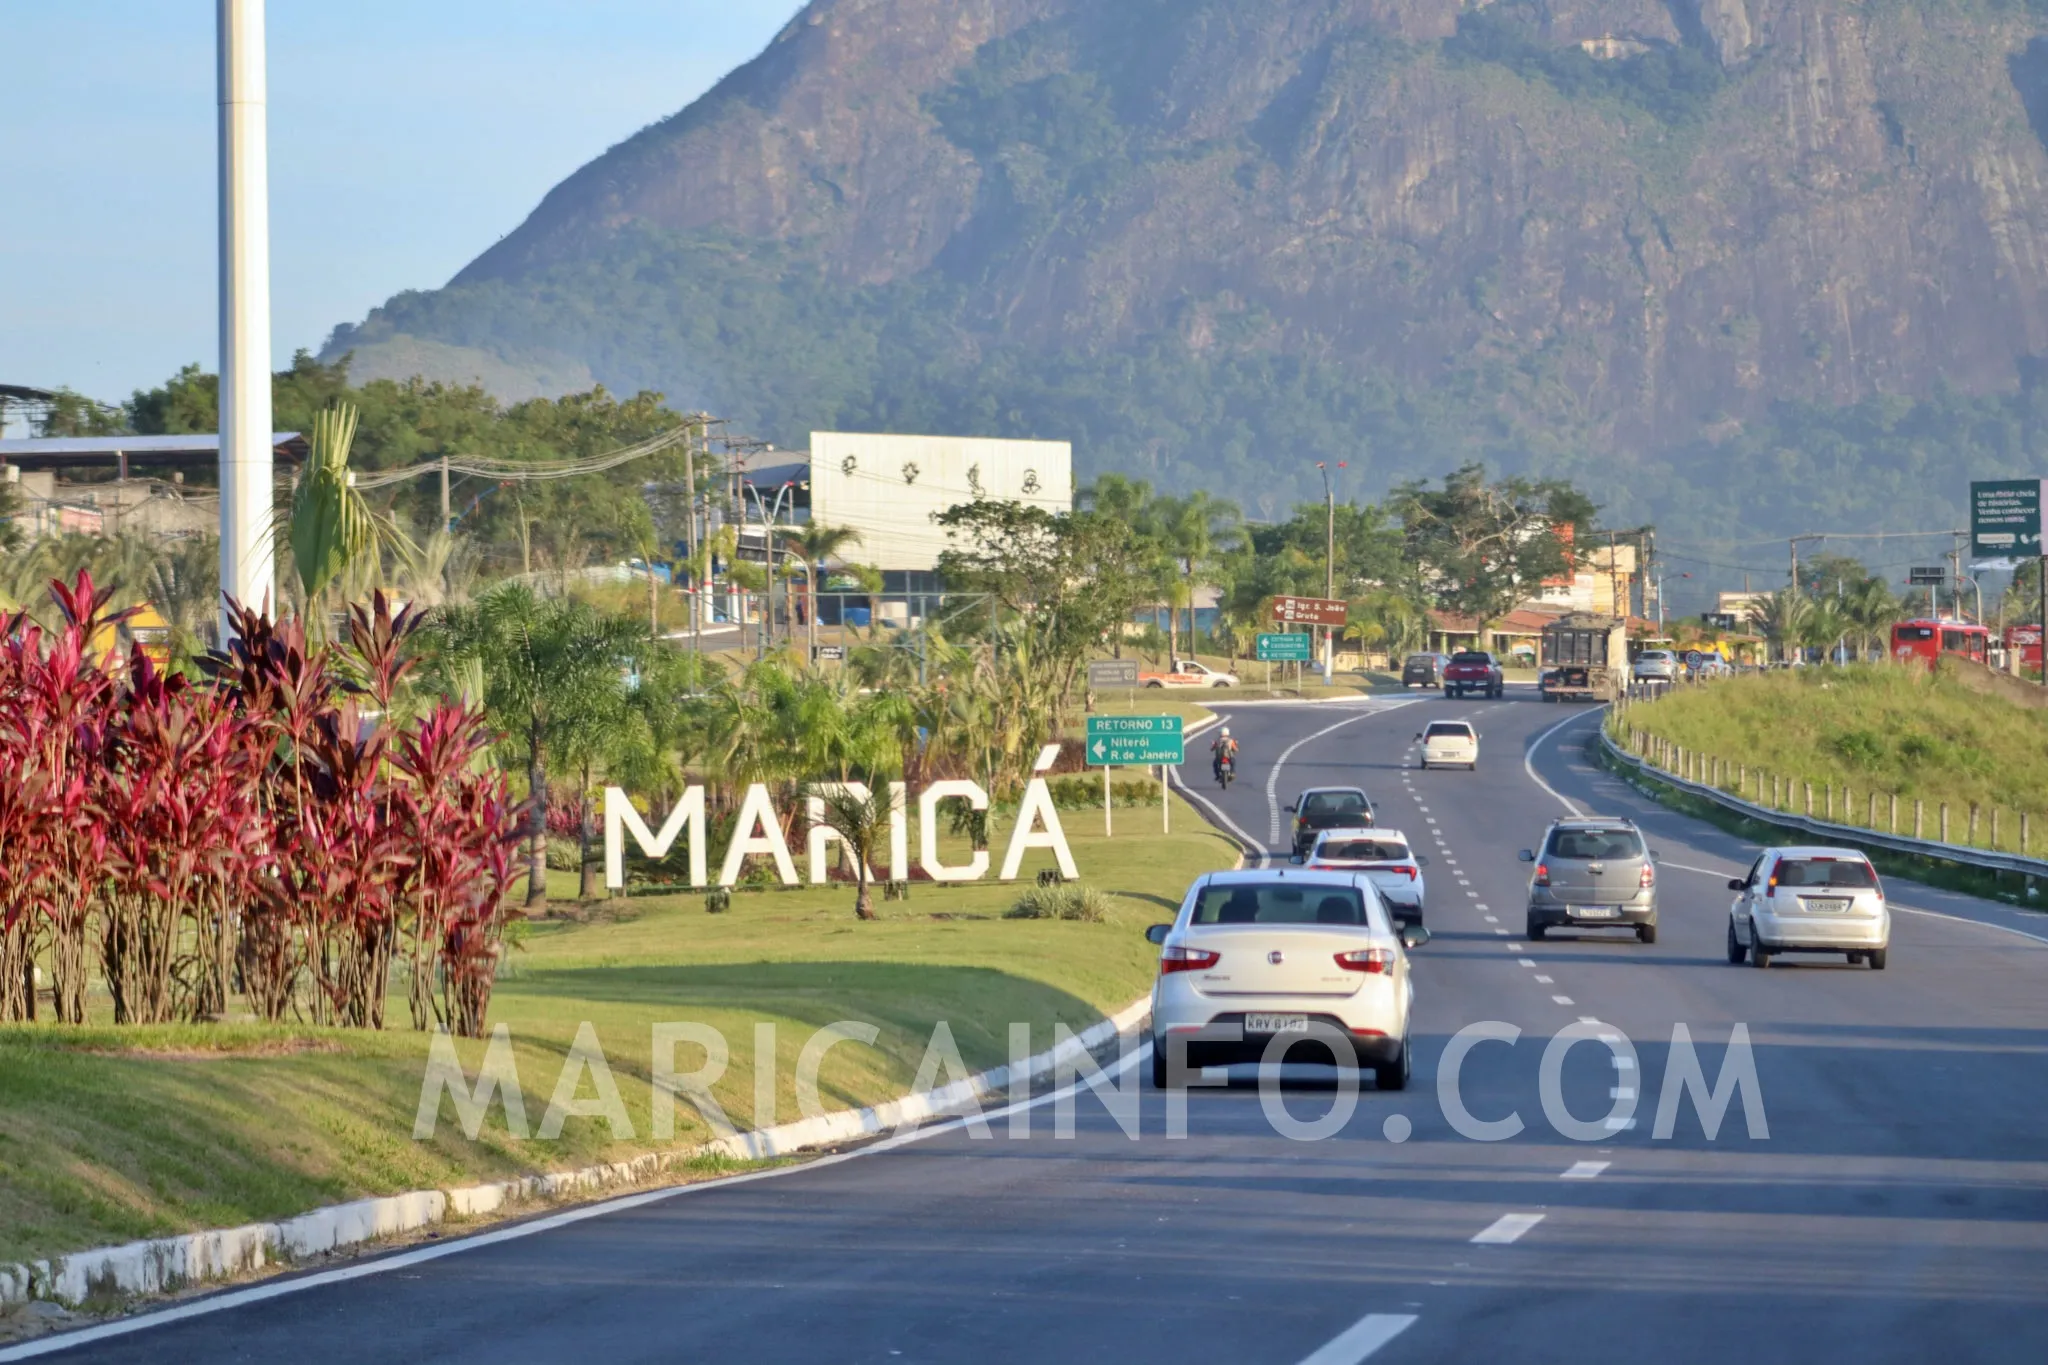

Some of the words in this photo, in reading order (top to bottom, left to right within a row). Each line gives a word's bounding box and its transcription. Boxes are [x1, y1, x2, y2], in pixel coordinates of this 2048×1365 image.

[1325, 603, 1345, 612] João
[1296, 611, 1319, 621] Gruta
[1096, 720, 1153, 730] RETORNO
[1161, 719, 1174, 730] 13
[1111, 736, 1150, 747] Niterói
[1139, 749, 1179, 760] Janeiro
[604, 743, 1080, 889] MARICÁ
